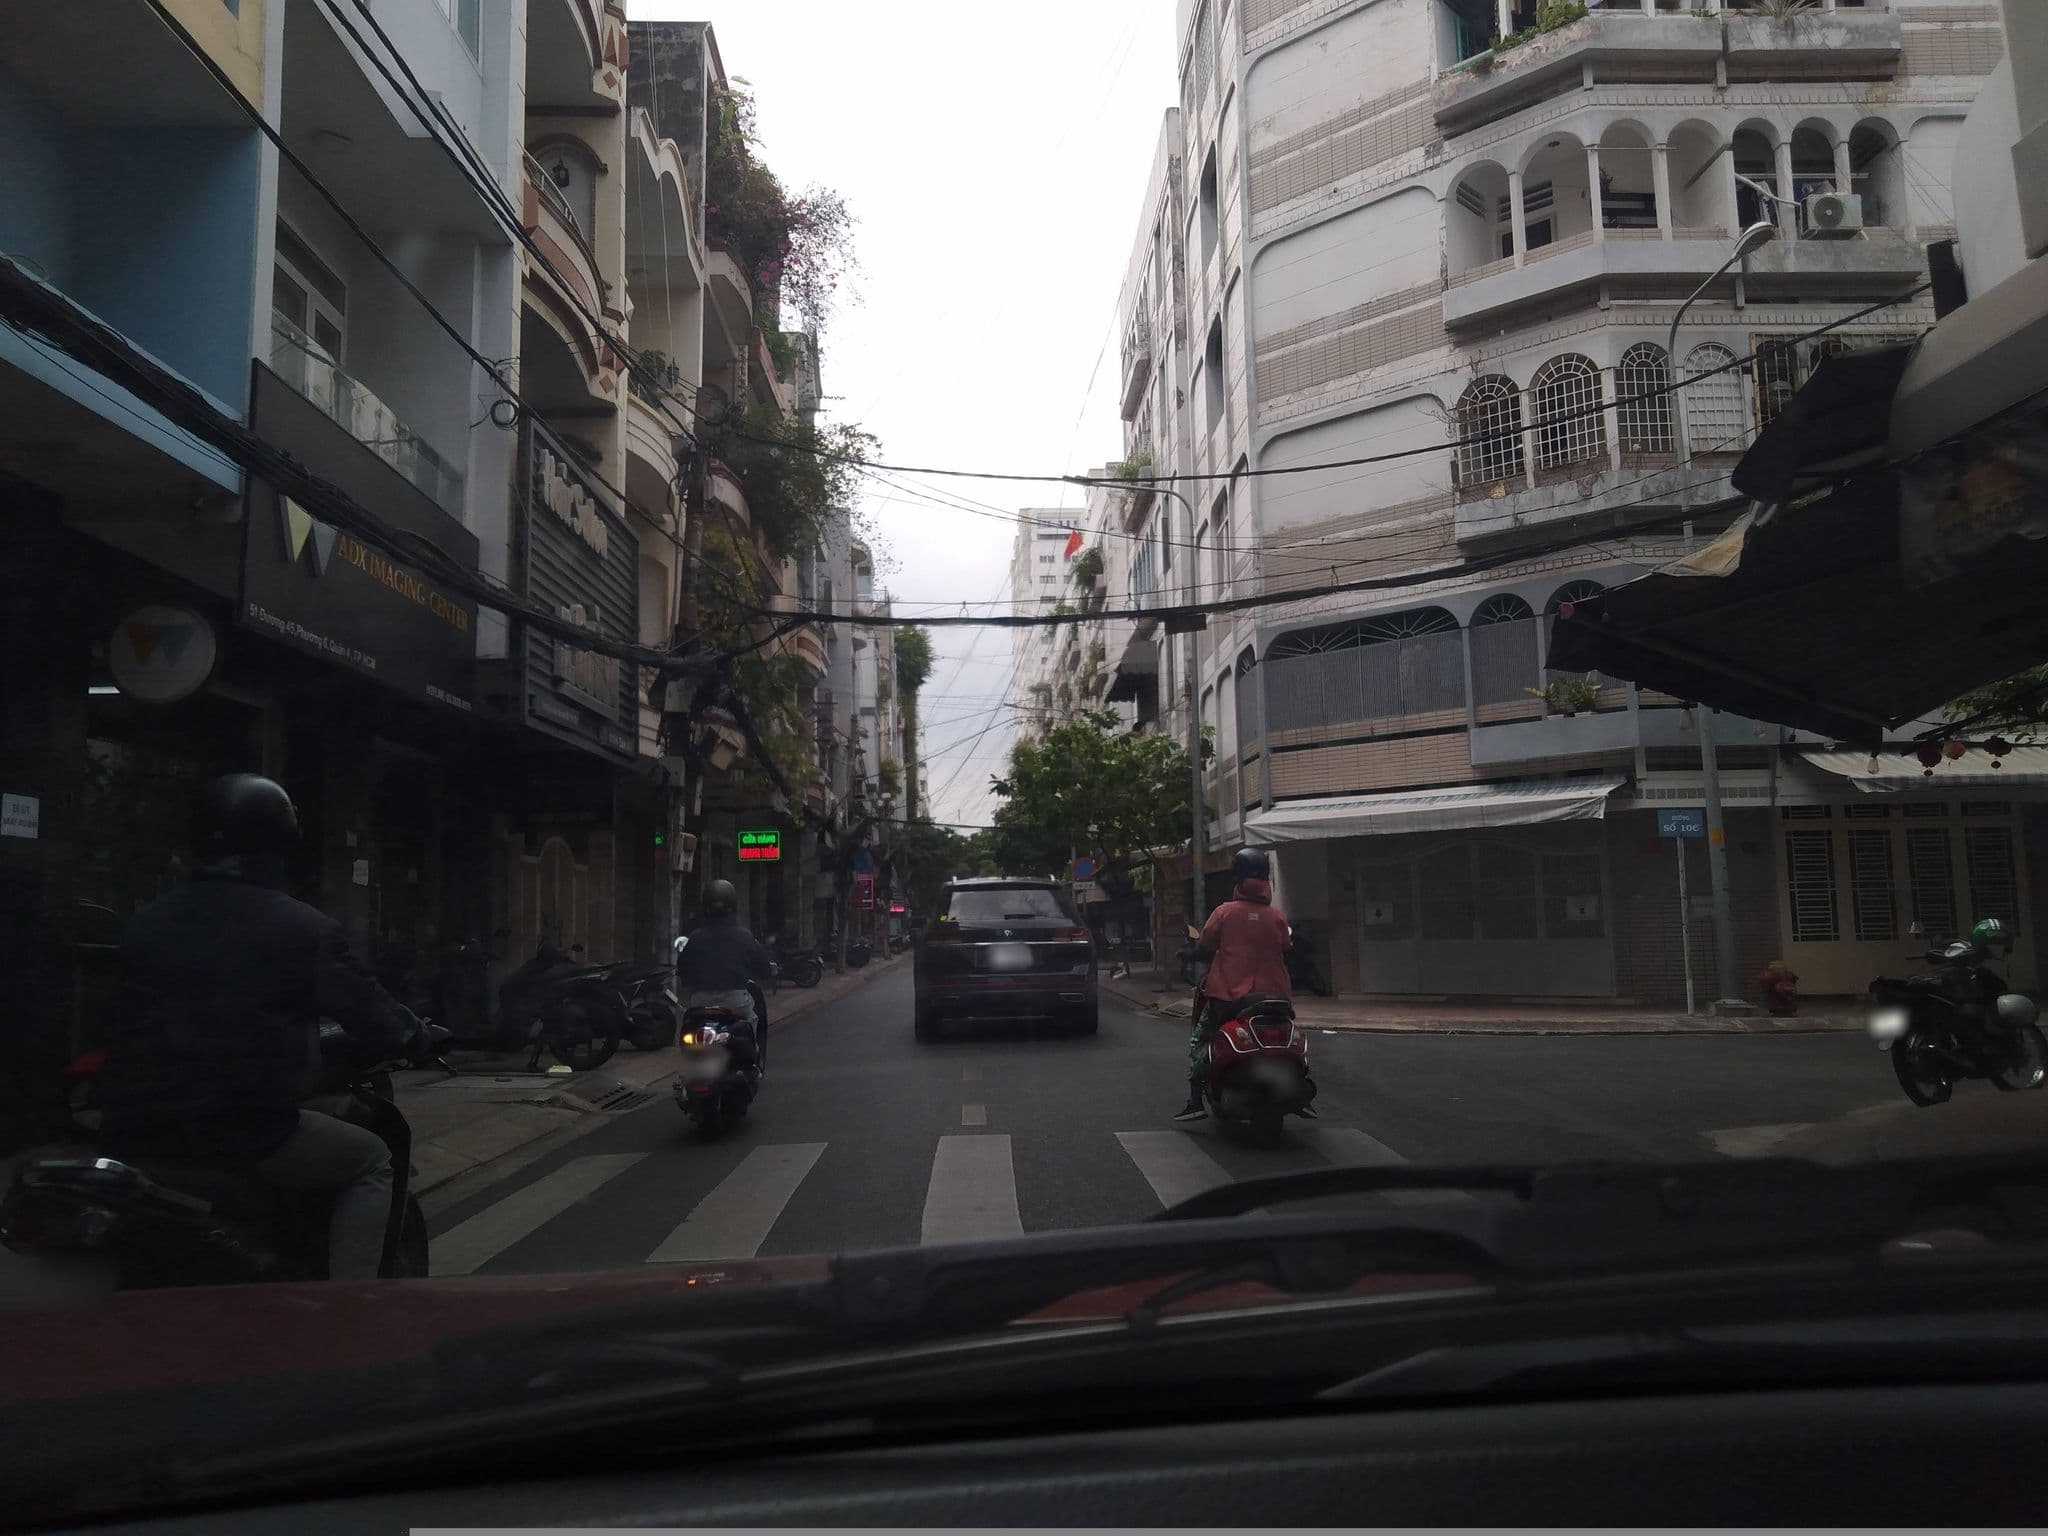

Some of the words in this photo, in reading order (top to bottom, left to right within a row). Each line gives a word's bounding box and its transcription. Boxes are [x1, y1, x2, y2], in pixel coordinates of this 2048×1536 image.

[338, 535, 368, 571] ADX
[370, 552, 426, 605] IMAGING
[430, 591, 469, 632] CENTER
[1663, 821, 1677, 832] SỐ
